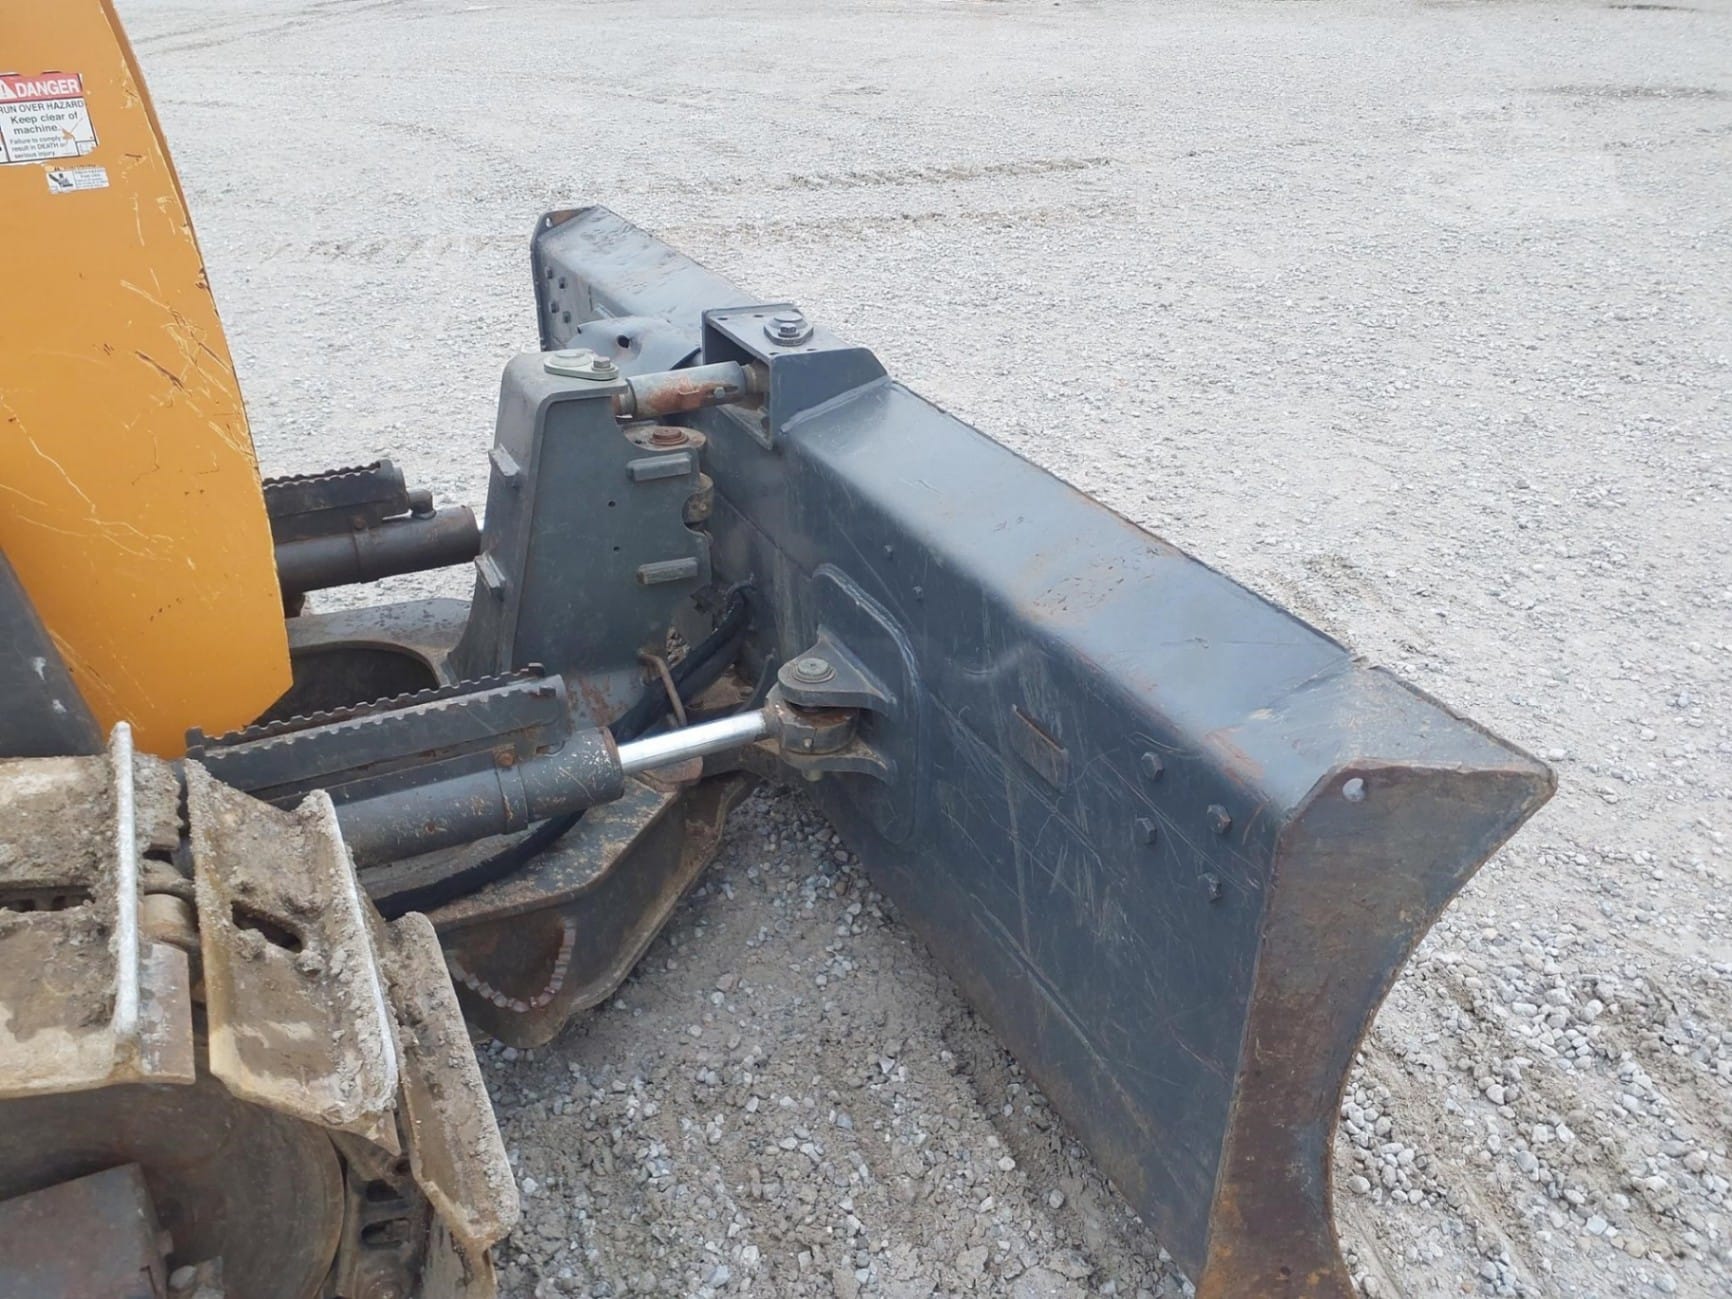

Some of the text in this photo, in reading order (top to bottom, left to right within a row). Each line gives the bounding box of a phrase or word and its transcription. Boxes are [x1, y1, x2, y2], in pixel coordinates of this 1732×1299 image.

[15, 79, 80, 97] DANGER
[18, 103, 44, 113] OVER
[47, 100, 84, 110] HAZARD
[11, 112, 78, 126] Keep clear of
[37, 142, 59, 150] DEATH
